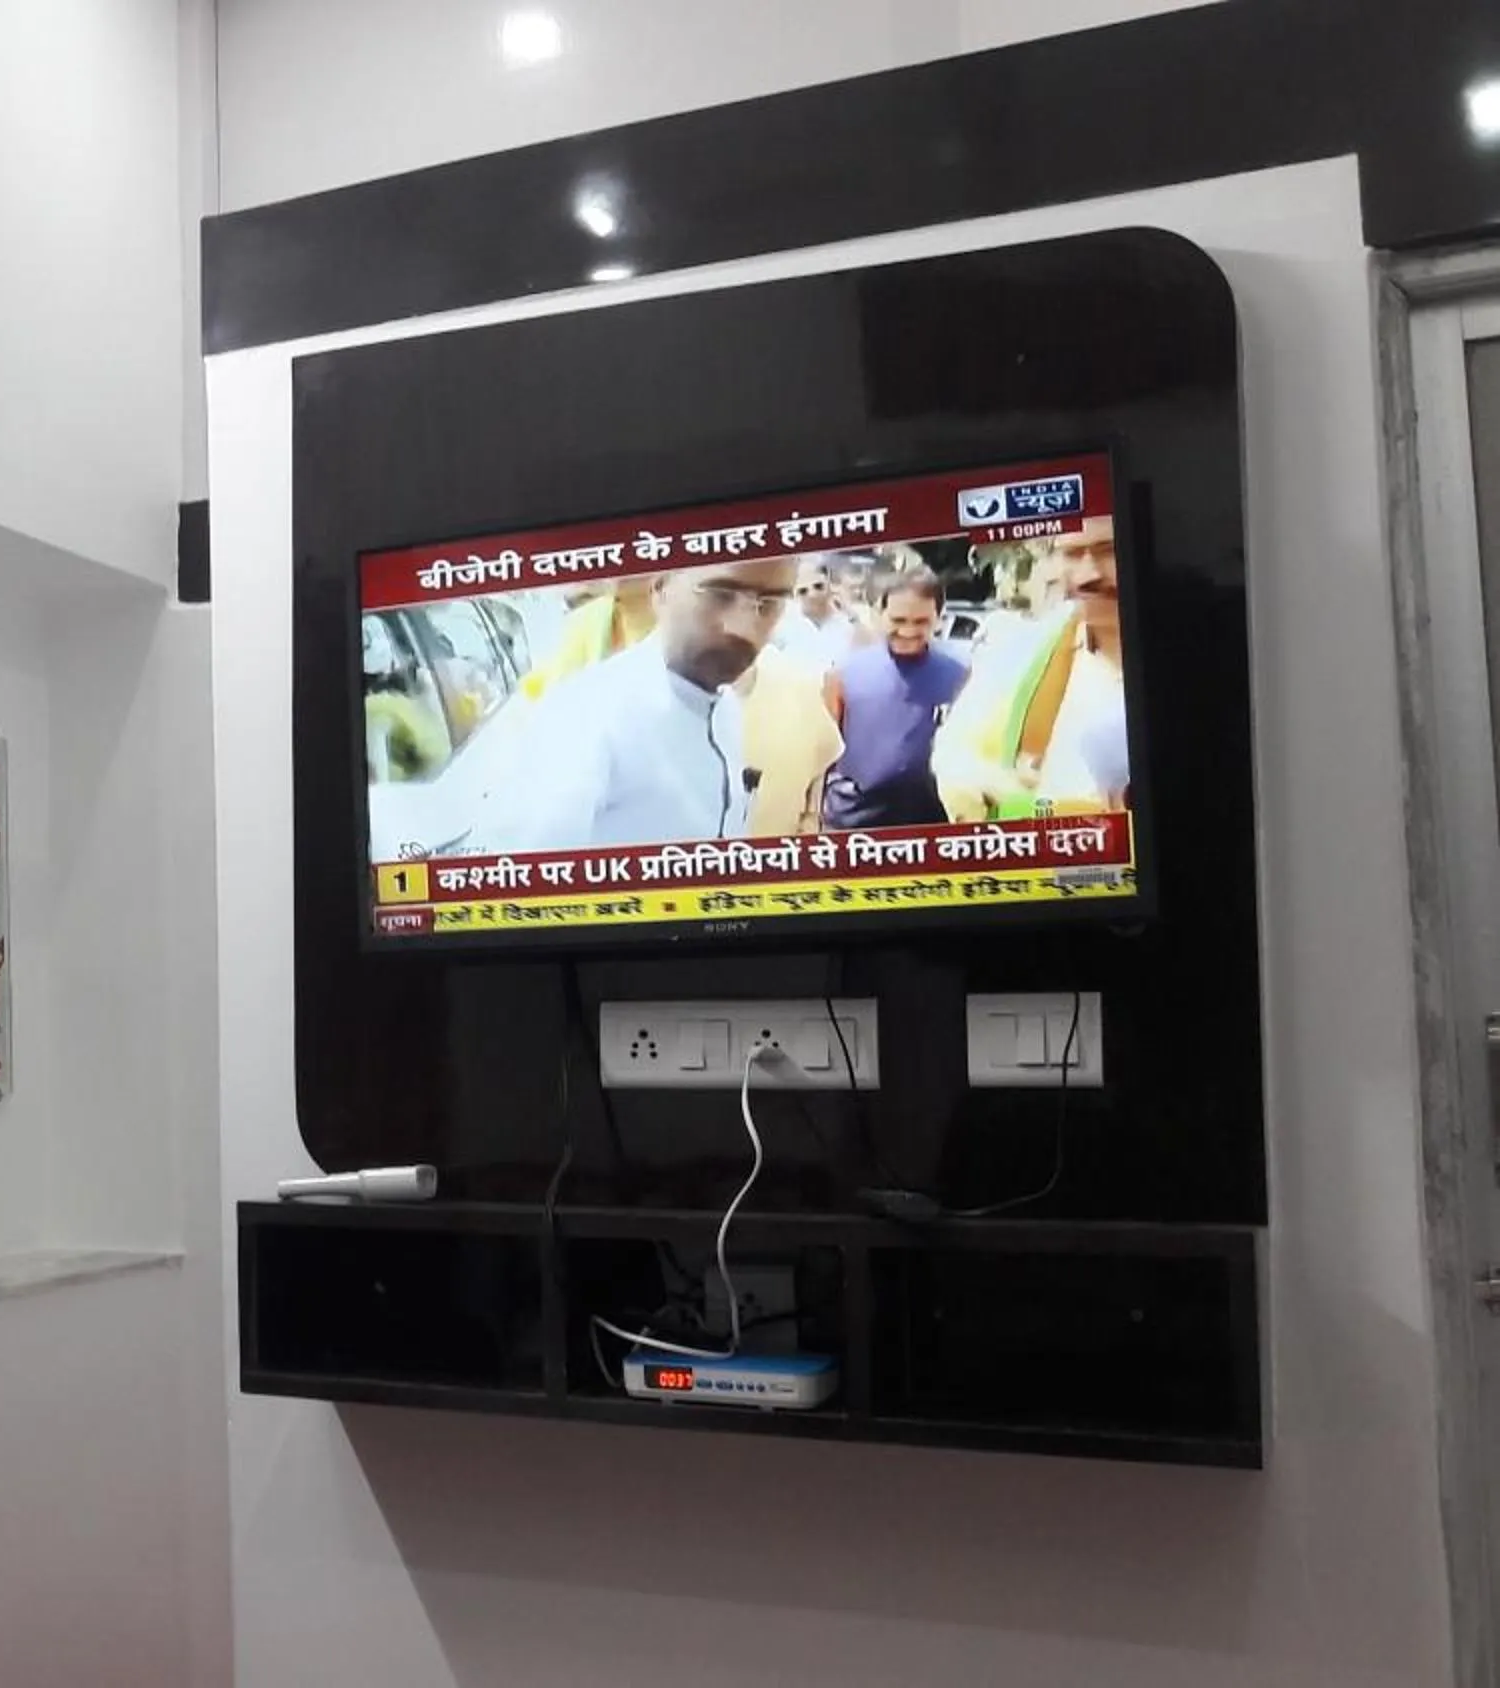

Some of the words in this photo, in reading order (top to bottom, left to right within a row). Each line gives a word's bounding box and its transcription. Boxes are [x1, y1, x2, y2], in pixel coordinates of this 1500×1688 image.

[1011, 482, 1072, 496] INDIA
[417, 549, 522, 589] बीजेपी
[530, 543, 624, 576] दफ्तर
[632, 531, 672, 561] के
[682, 523, 768, 554] बाहर
[776, 511, 888, 547] हंगामा
[436, 857, 531, 892] कश्मीर
[539, 860, 574, 886] पर
[584, 857, 631, 883] UK
[639, 838, 801, 881] प्रतिनिधियों
[808, 837, 838, 869] से
[847, 832, 927, 868] मिला
[936, 825, 1038, 861] कांग्रेस
[1045, 827, 1106, 856] दल
[393, 871, 408, 893] 1
